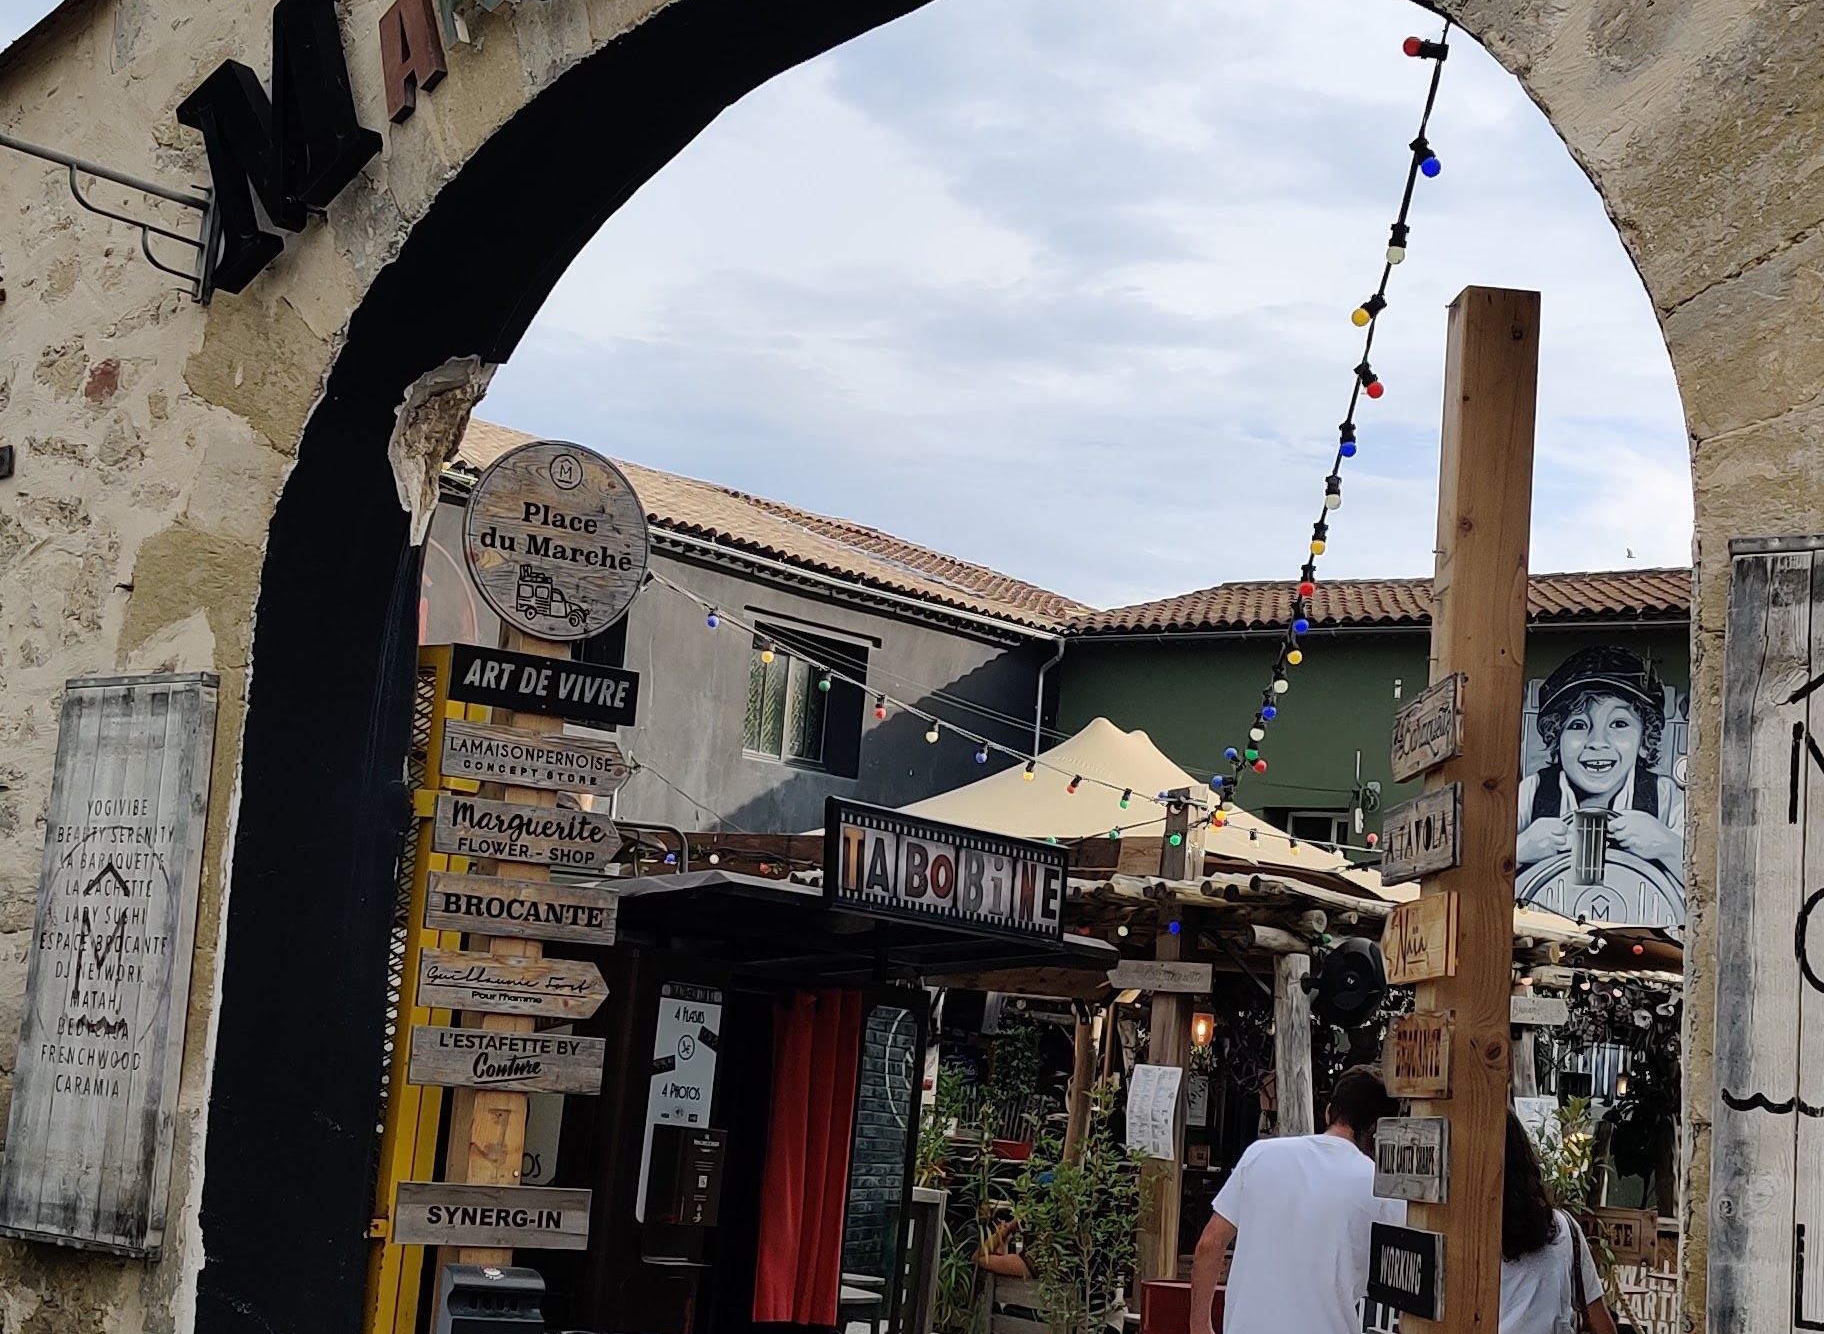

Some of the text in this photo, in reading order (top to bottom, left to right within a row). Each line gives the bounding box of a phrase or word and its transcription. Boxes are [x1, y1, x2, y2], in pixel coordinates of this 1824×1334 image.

[521, 500, 599, 535] Place
[479, 526, 633, 572] du Marché
[462, 657, 631, 709] ART DE VIVRE
[449, 736, 614, 773] LAMAISONPERNOISE
[463, 758, 598, 786] CONCEPT STORE
[87, 798, 149, 817] YOGIVIBE
[57, 824, 175, 844] BEAUTY SERENITY
[451, 799, 607, 845] Marguerite
[60, 852, 165, 871] LA BARAQUETTE
[457, 836, 531, 860] FLOWER
[548, 847, 596, 866] SHOP
[65, 879, 79, 897] LA
[64, 905, 147, 926] LADY SUSHI
[441, 892, 605, 929] BROCANTE
[39, 931, 169, 956] ESPACE BROCANTE
[55, 959, 70, 980] DJ
[471, 990, 498, 1001] Pour
[674, 1005, 681, 1021] 4
[438, 1031, 582, 1056] L'ESTAFETTE BY
[41, 1043, 142, 1071] FRENCHWOOD
[55, 1073, 120, 1099] CARAMIA
[661, 1081, 701, 1101] 4 PHOTOS
[426, 1204, 563, 1230] SYNERG-IN
[1379, 1243, 1423, 1296] WORKING
